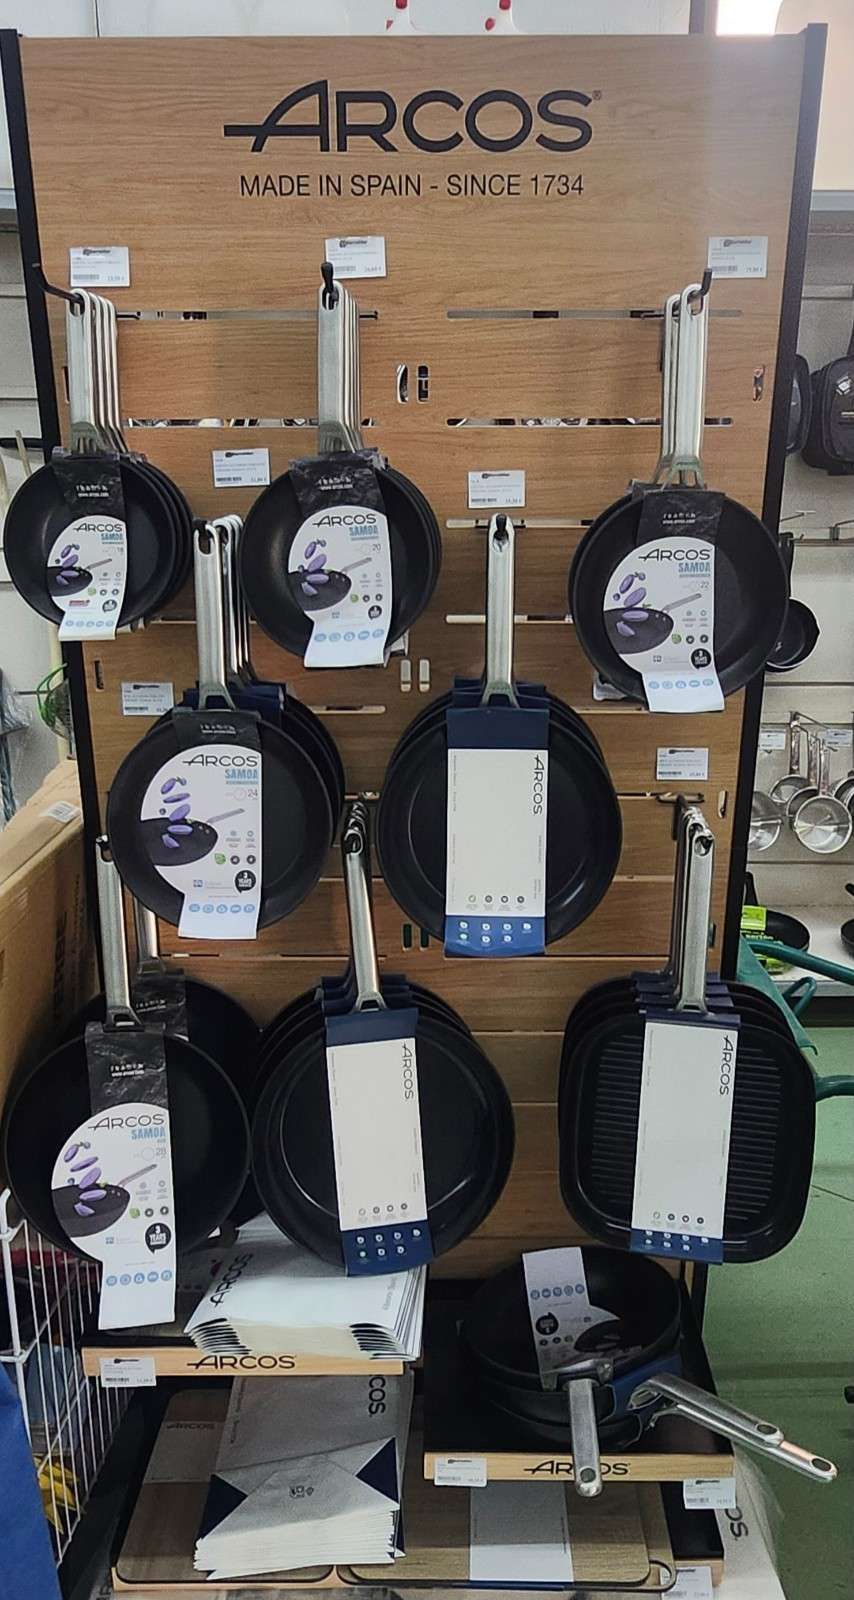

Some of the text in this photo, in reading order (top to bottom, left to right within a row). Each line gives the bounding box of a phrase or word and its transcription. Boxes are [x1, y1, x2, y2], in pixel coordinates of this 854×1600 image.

[224, 80, 593, 152] ARCOS
[240, 175, 311, 196] MADE
[319, 175, 342, 196] IN
[350, 174, 421, 197] SPAIN
[446, 174, 521, 197] SINCE
[531, 174, 584, 196] 1734
[73, 522, 123, 532] ARCOS
[312, 513, 377, 528] ARCOS
[638, 548, 711, 562] ARCOS
[678, 561, 711, 573] SAMOA
[182, 753, 258, 768] ARCOS
[224, 768, 259, 780] SAMOA
[533, 754, 545, 816] ARCOS
[402, 1042, 414, 1100] ARCOS
[720, 1035, 734, 1095] ARCOS
[88, 1113, 165, 1131] ARCOS
[131, 1126, 166, 1141] SAMOA
[211, 1253, 254, 1308] ARCOS
[187, 1354, 296, 1370] ARCOS
[524, 1460, 630, 1476] AROS
